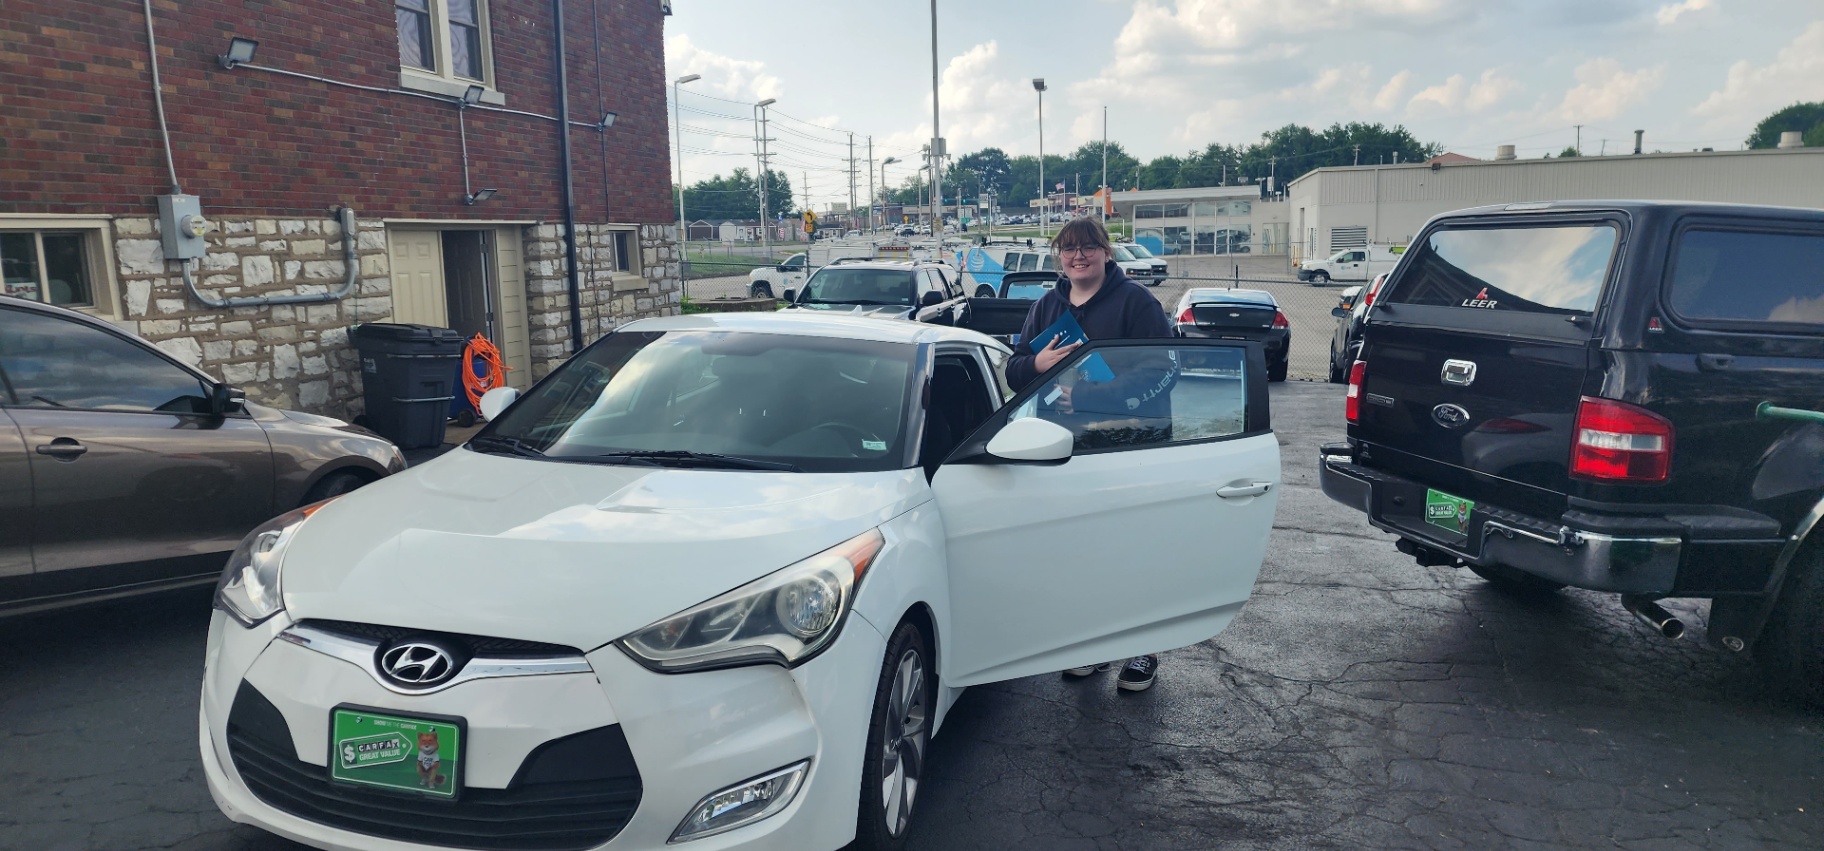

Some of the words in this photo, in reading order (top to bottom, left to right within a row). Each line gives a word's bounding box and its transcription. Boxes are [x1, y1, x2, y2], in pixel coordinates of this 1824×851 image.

[1461, 298, 1498, 309] LEER
[357, 740, 400, 752] CARFAX
[359, 752, 379, 761] GREAT
[380, 749, 400, 758] VALUE
